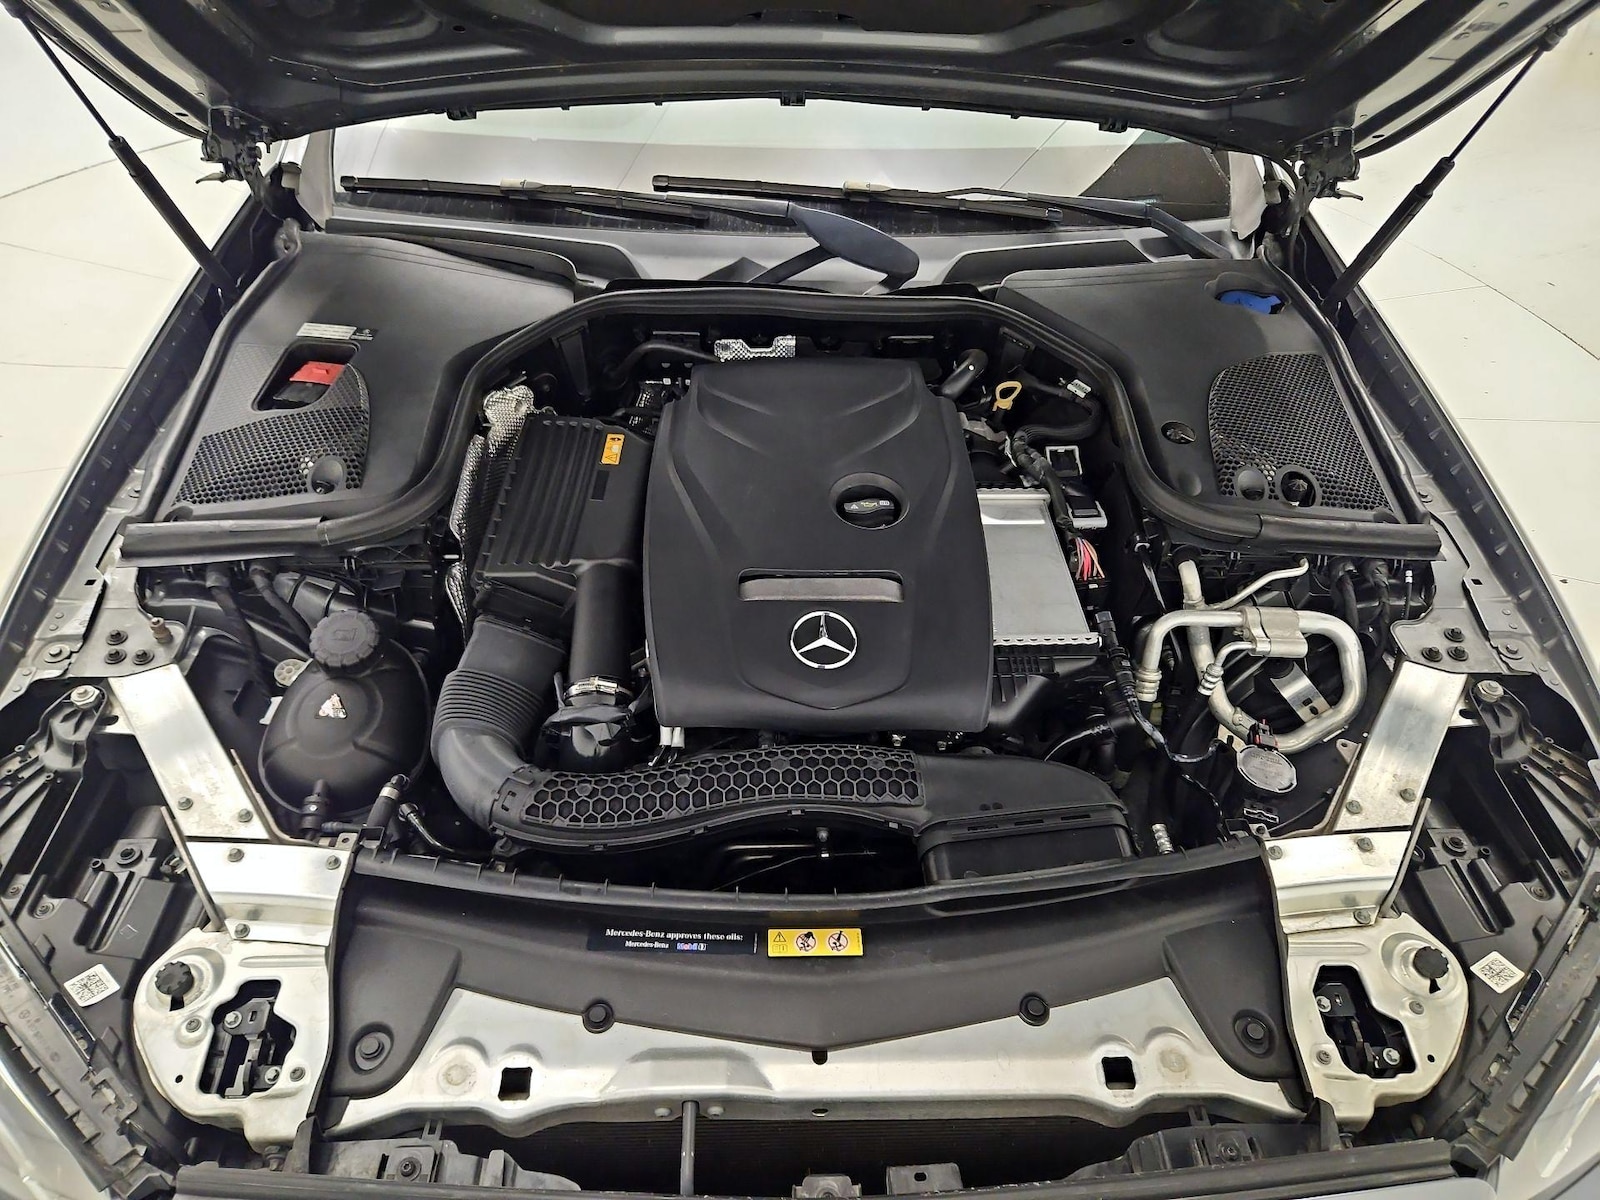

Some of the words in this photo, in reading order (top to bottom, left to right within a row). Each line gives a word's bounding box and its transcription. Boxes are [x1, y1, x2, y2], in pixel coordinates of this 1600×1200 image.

[605, 928, 665, 938] Mercedes-Benz
[666, 932, 702, 940] approves
[625, 940, 669, 949] Mercedes-Benz
